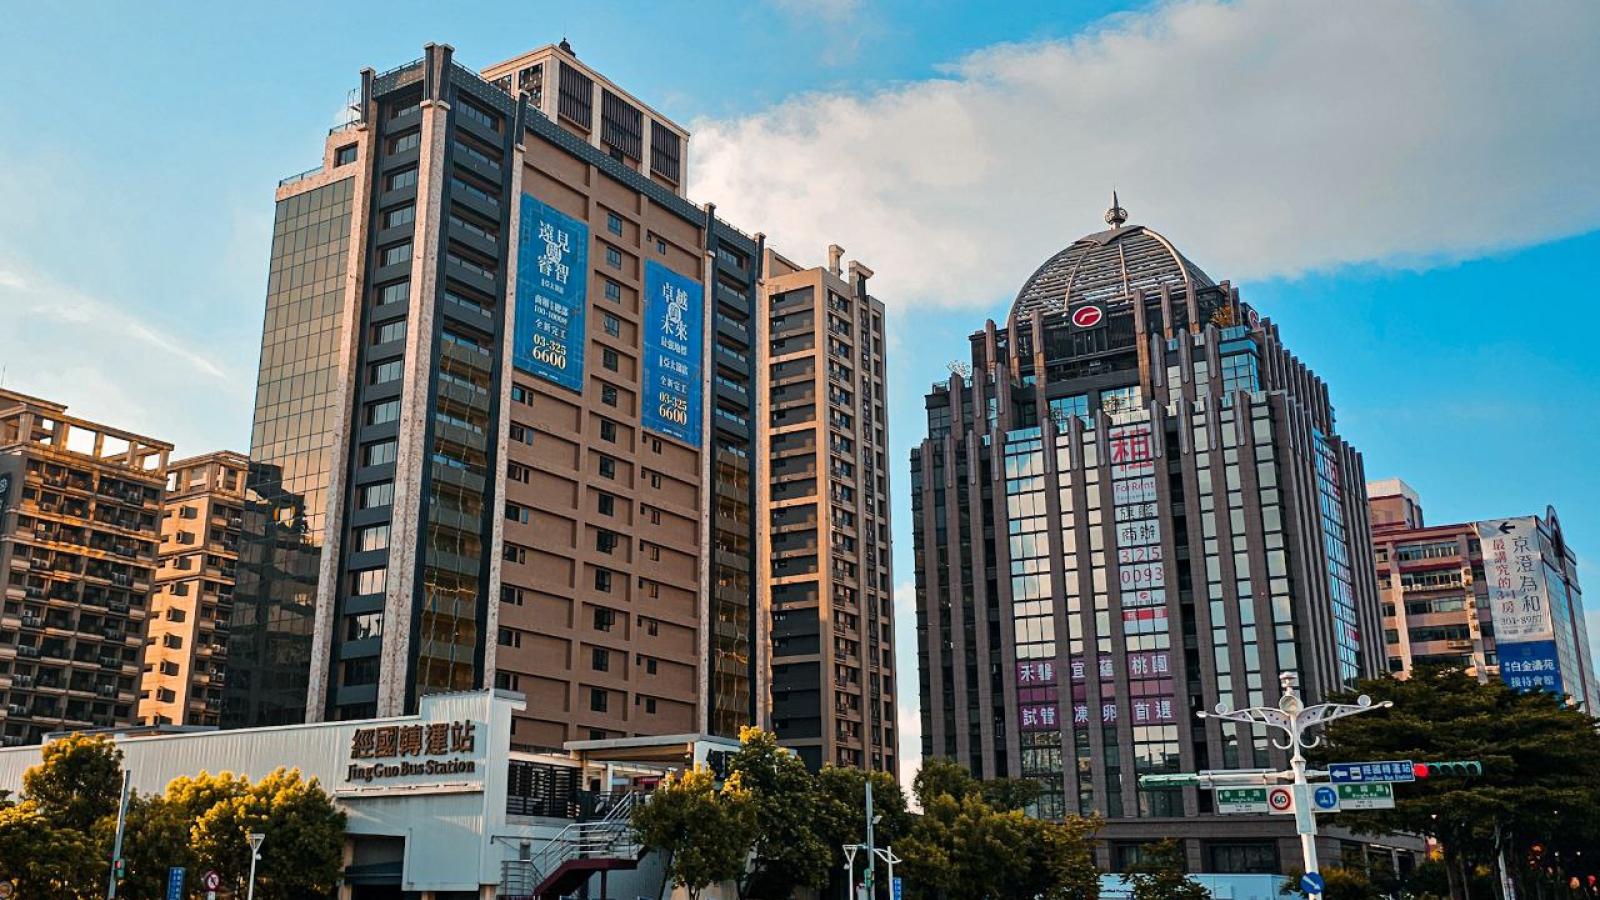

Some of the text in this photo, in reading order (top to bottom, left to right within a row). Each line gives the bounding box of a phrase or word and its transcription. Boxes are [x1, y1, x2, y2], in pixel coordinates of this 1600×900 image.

[533, 333, 567, 356] 03-325
[532, 345, 566, 370] 6600
[659, 391, 688, 411] 03-325
[659, 403, 687, 426] 6600
[1110, 427, 1153, 472] 租
[1120, 546, 1161, 564] 325
[1121, 566, 1164, 584] 0093
[350, 719, 476, 760] 經國轉運站
[345, 757, 476, 783] Jing Guo Bus Station
